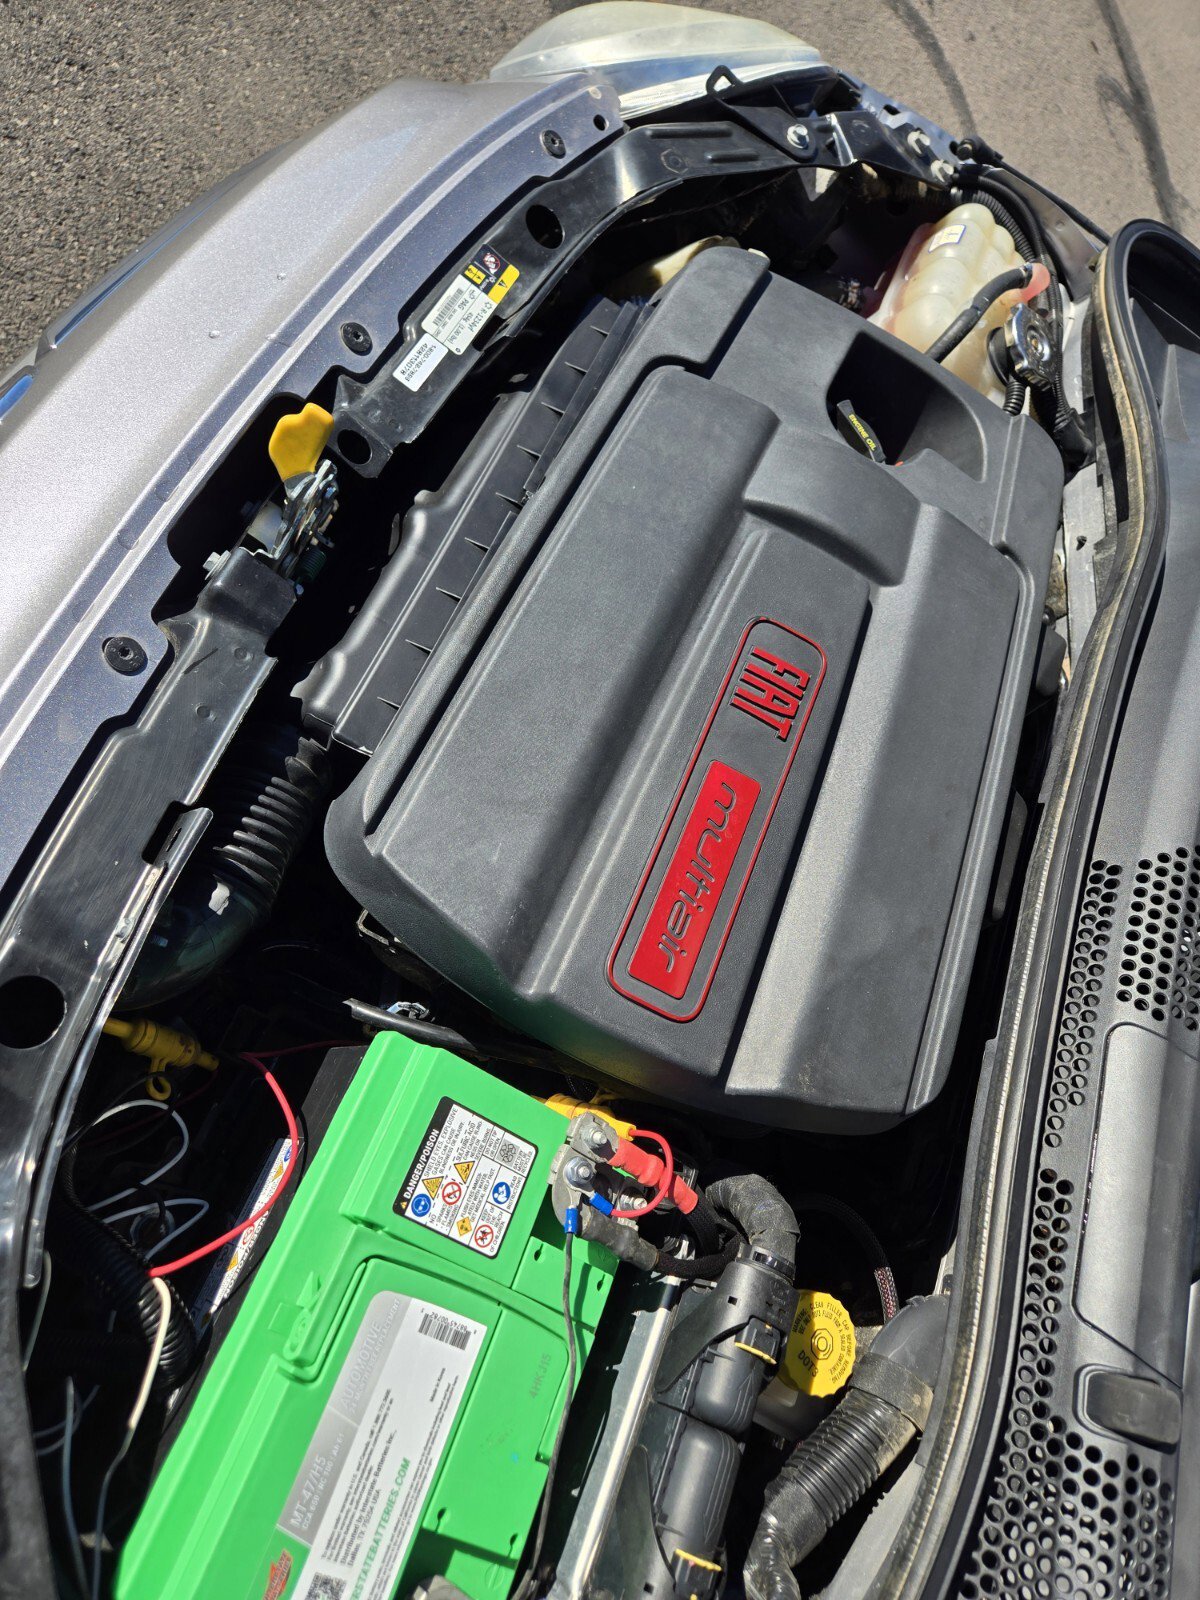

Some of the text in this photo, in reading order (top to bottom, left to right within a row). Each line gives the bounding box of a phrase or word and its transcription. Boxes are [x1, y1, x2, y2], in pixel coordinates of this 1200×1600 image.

[457, 297, 469, 310] PAG
[466, 306, 487, 333] R-1234yf
[848, 413, 876, 450] ENGINE OIL
[730, 646, 811, 741] FIAT
[657, 780, 739, 973] multiair
[423, 1155, 436, 1177] SHIELD
[440, 1107, 458, 1139] EXPLOSIVE
[431, 1127, 456, 1175] GASES CAN CAUSE
[455, 1122, 476, 1161] SULFURIC ACID
[462, 1149, 470, 1160] CAN
[466, 1134, 477, 1150] CAUSE
[403, 1128, 439, 1198] DANGER/POISON
[438, 1146, 454, 1174] BLINDNESS
[466, 1189, 475, 1202] EYES
[429, 1213, 436, 1224] NO
[435, 1203, 448, 1223] SPARKS
[440, 1204, 453, 1225] FLAMES
[445, 1204, 459, 1227] SMOKING
[809, 1301, 823, 1309] CLEAN
[826, 1302, 842, 1318] FILLER
[373, 1297, 401, 1352] REPLACEMENT
[338, 1320, 382, 1408] AUTOMOTIVE
[797, 1349, 818, 1377] DOT3
[289, 1453, 327, 1526] MT-47/H5
[301, 1510, 313, 1529] CCA
[317, 1476, 327, 1489] RC
[330, 1442, 340, 1455] Ah
[370, 1488, 380, 1504] USA
